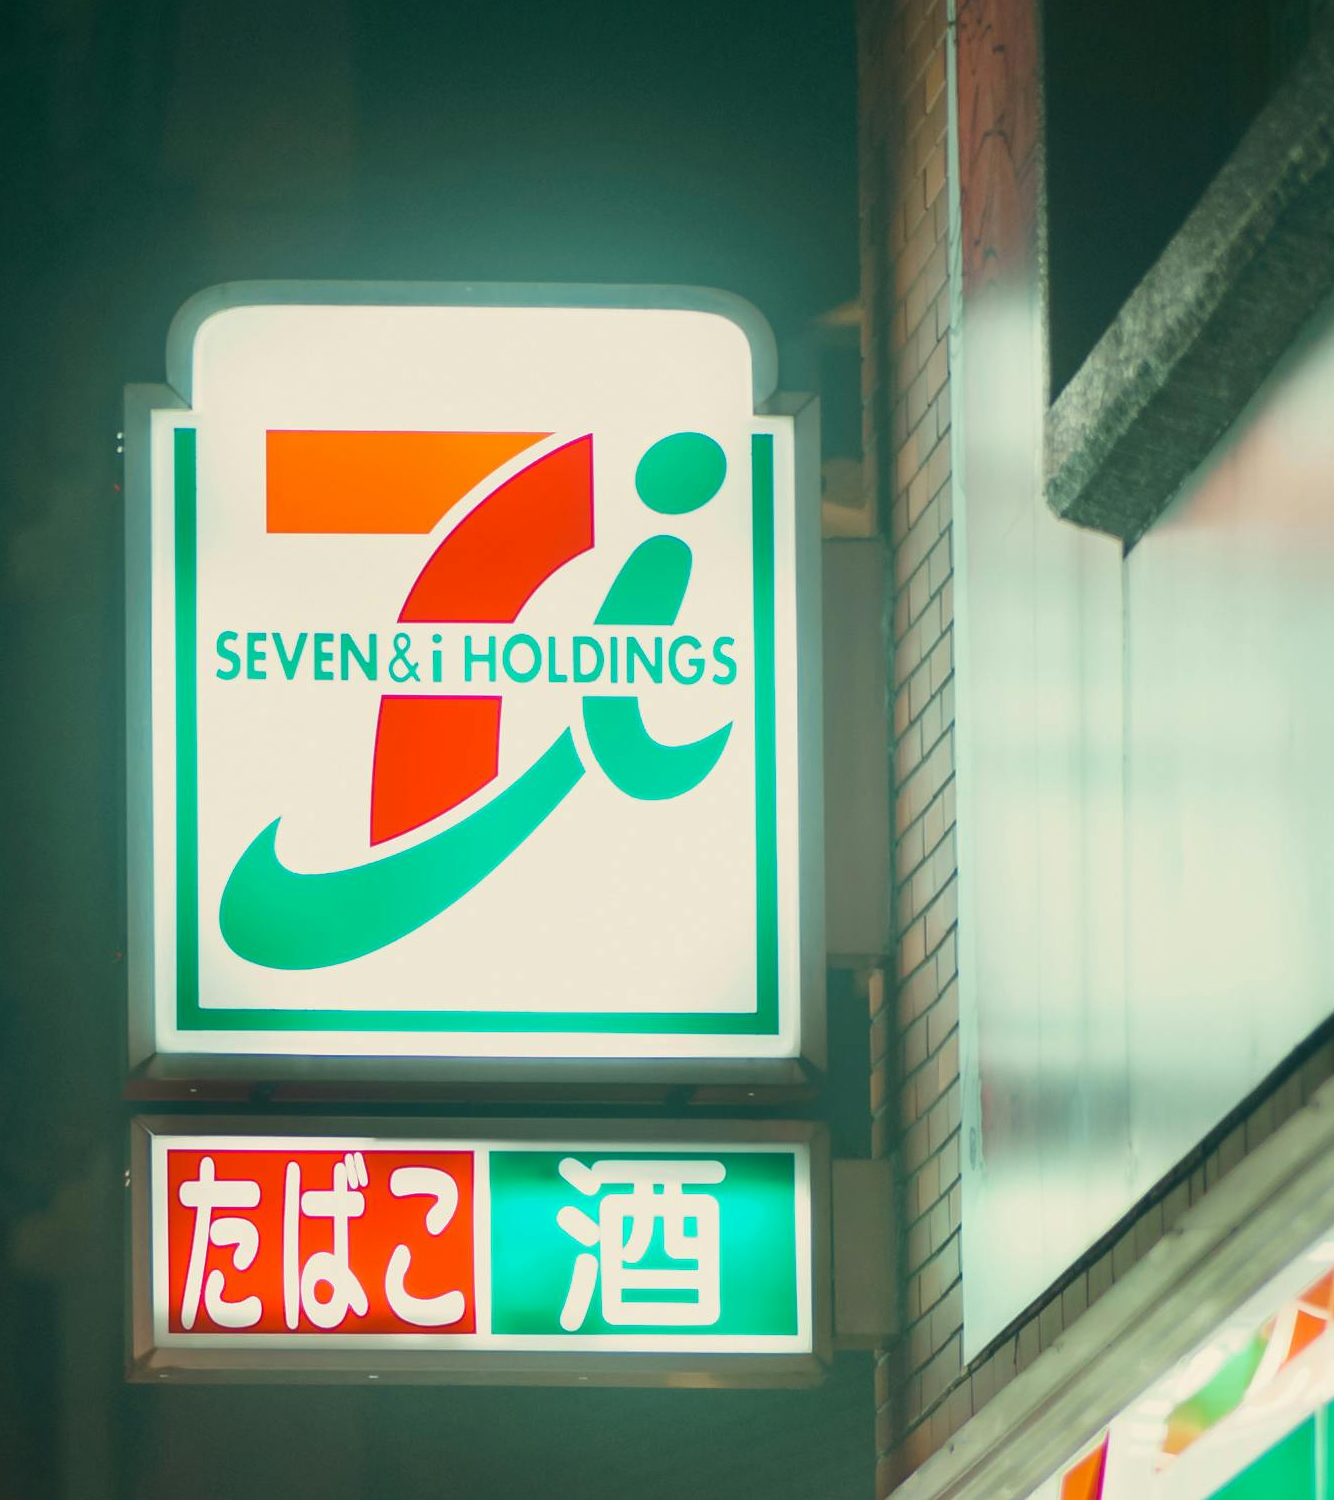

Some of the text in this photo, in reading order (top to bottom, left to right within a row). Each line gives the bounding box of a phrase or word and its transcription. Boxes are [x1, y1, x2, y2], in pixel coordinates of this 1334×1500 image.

[464, 633, 738, 686] HOLDINGS
[178, 1151, 466, 1331] たばこ
[555, 1156, 727, 1332] 酒
